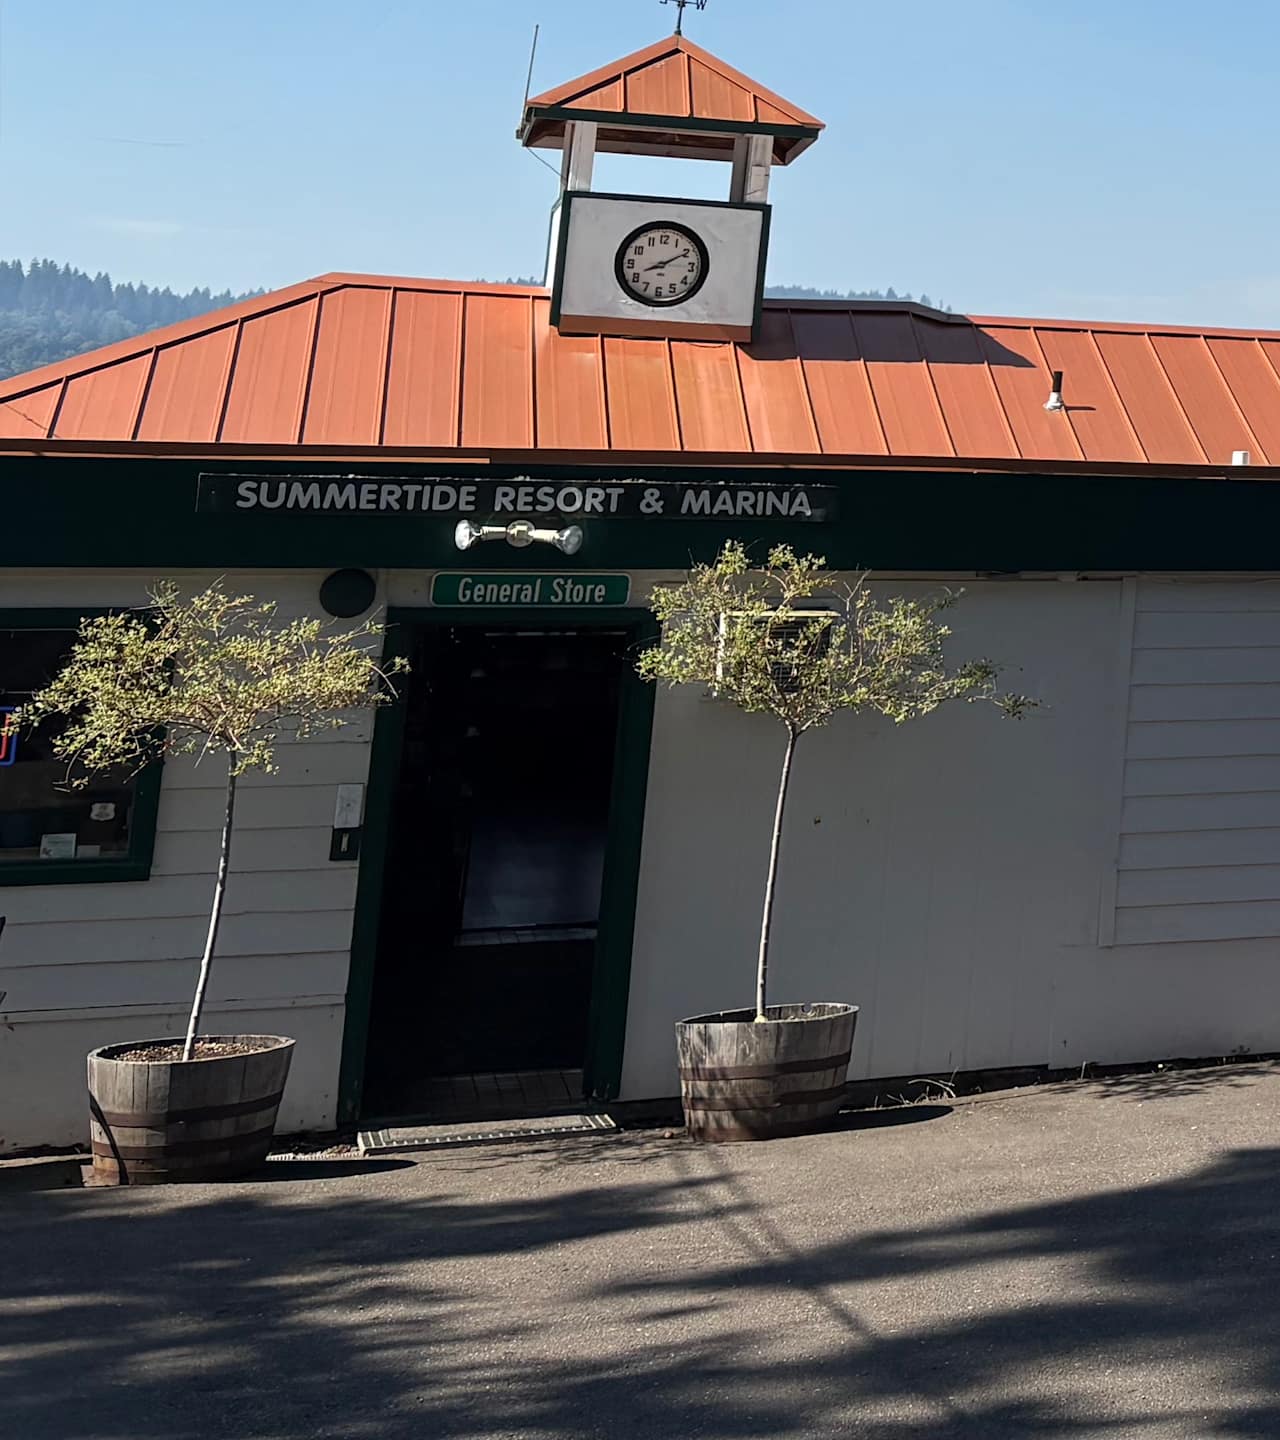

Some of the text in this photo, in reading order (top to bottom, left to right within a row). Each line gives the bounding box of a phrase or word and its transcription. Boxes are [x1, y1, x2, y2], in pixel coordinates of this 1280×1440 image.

[648, 237, 655, 247] 11
[659, 235, 670, 245] 12
[634, 246, 644, 255] 10
[682, 248, 690, 258] 2
[627, 259, 635, 269] 9
[688, 262, 695, 272] 3
[632, 273, 640, 283] 8
[680, 275, 688, 285] 4
[642, 282, 650, 292] 7
[655, 287, 662, 297] 6
[669, 283, 677, 293] 5
[235, 481, 813, 517] SUMMERTIDE RESORT & MARINA
[458, 577, 606, 603] General Store
